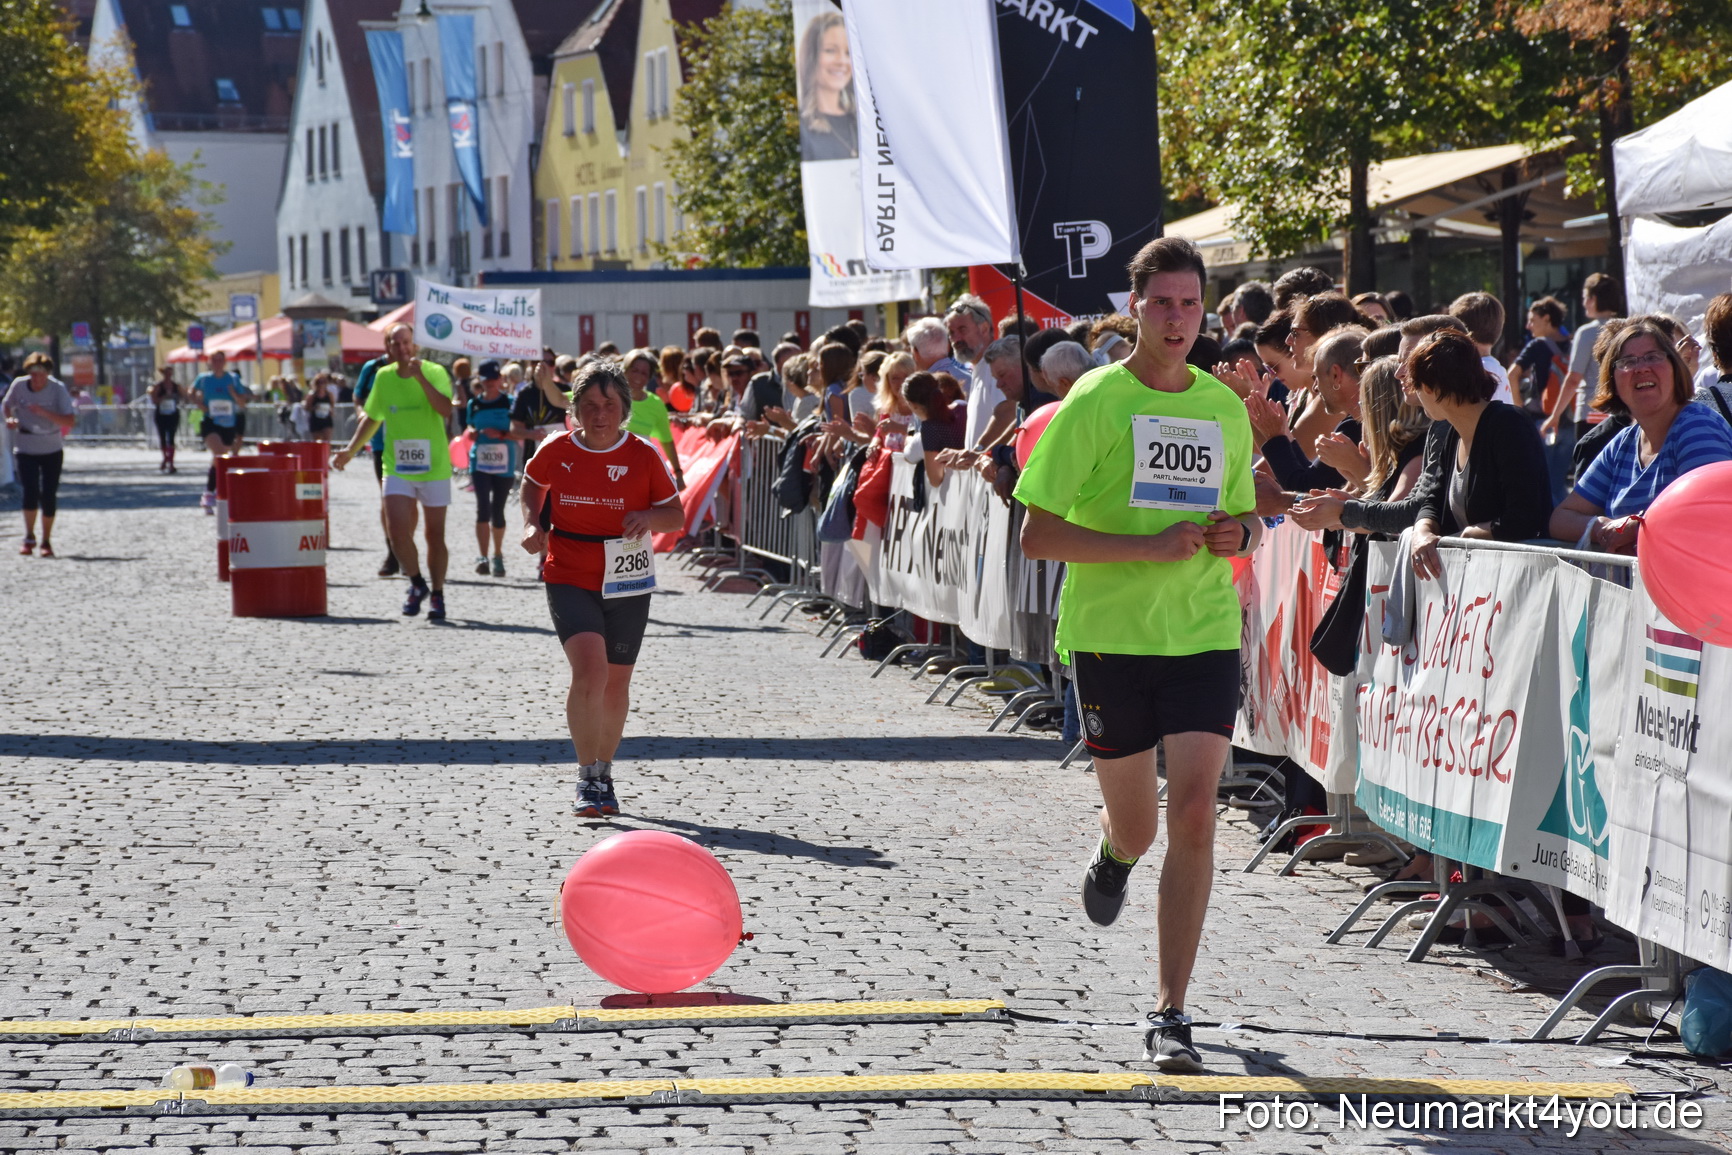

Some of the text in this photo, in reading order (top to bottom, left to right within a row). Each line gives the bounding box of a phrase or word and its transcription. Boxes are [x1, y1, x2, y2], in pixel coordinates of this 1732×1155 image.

[427, 287, 536, 318] Mit uns läufts
[460, 317, 533, 340] Grundschule
[1041, 316, 1068, 330] THE
[463, 340, 483, 352] Haus
[503, 344, 539, 357] Marien
[1160, 424, 1199, 438] BOCK
[398, 449, 426, 461] 2166
[1148, 441, 1212, 474] 2005
[1152, 473, 1198, 483] PARTL Neumarkt
[1168, 487, 1188, 501] Tim
[613, 549, 650, 575] 2368
[1532, 843, 1558, 869] Jura
